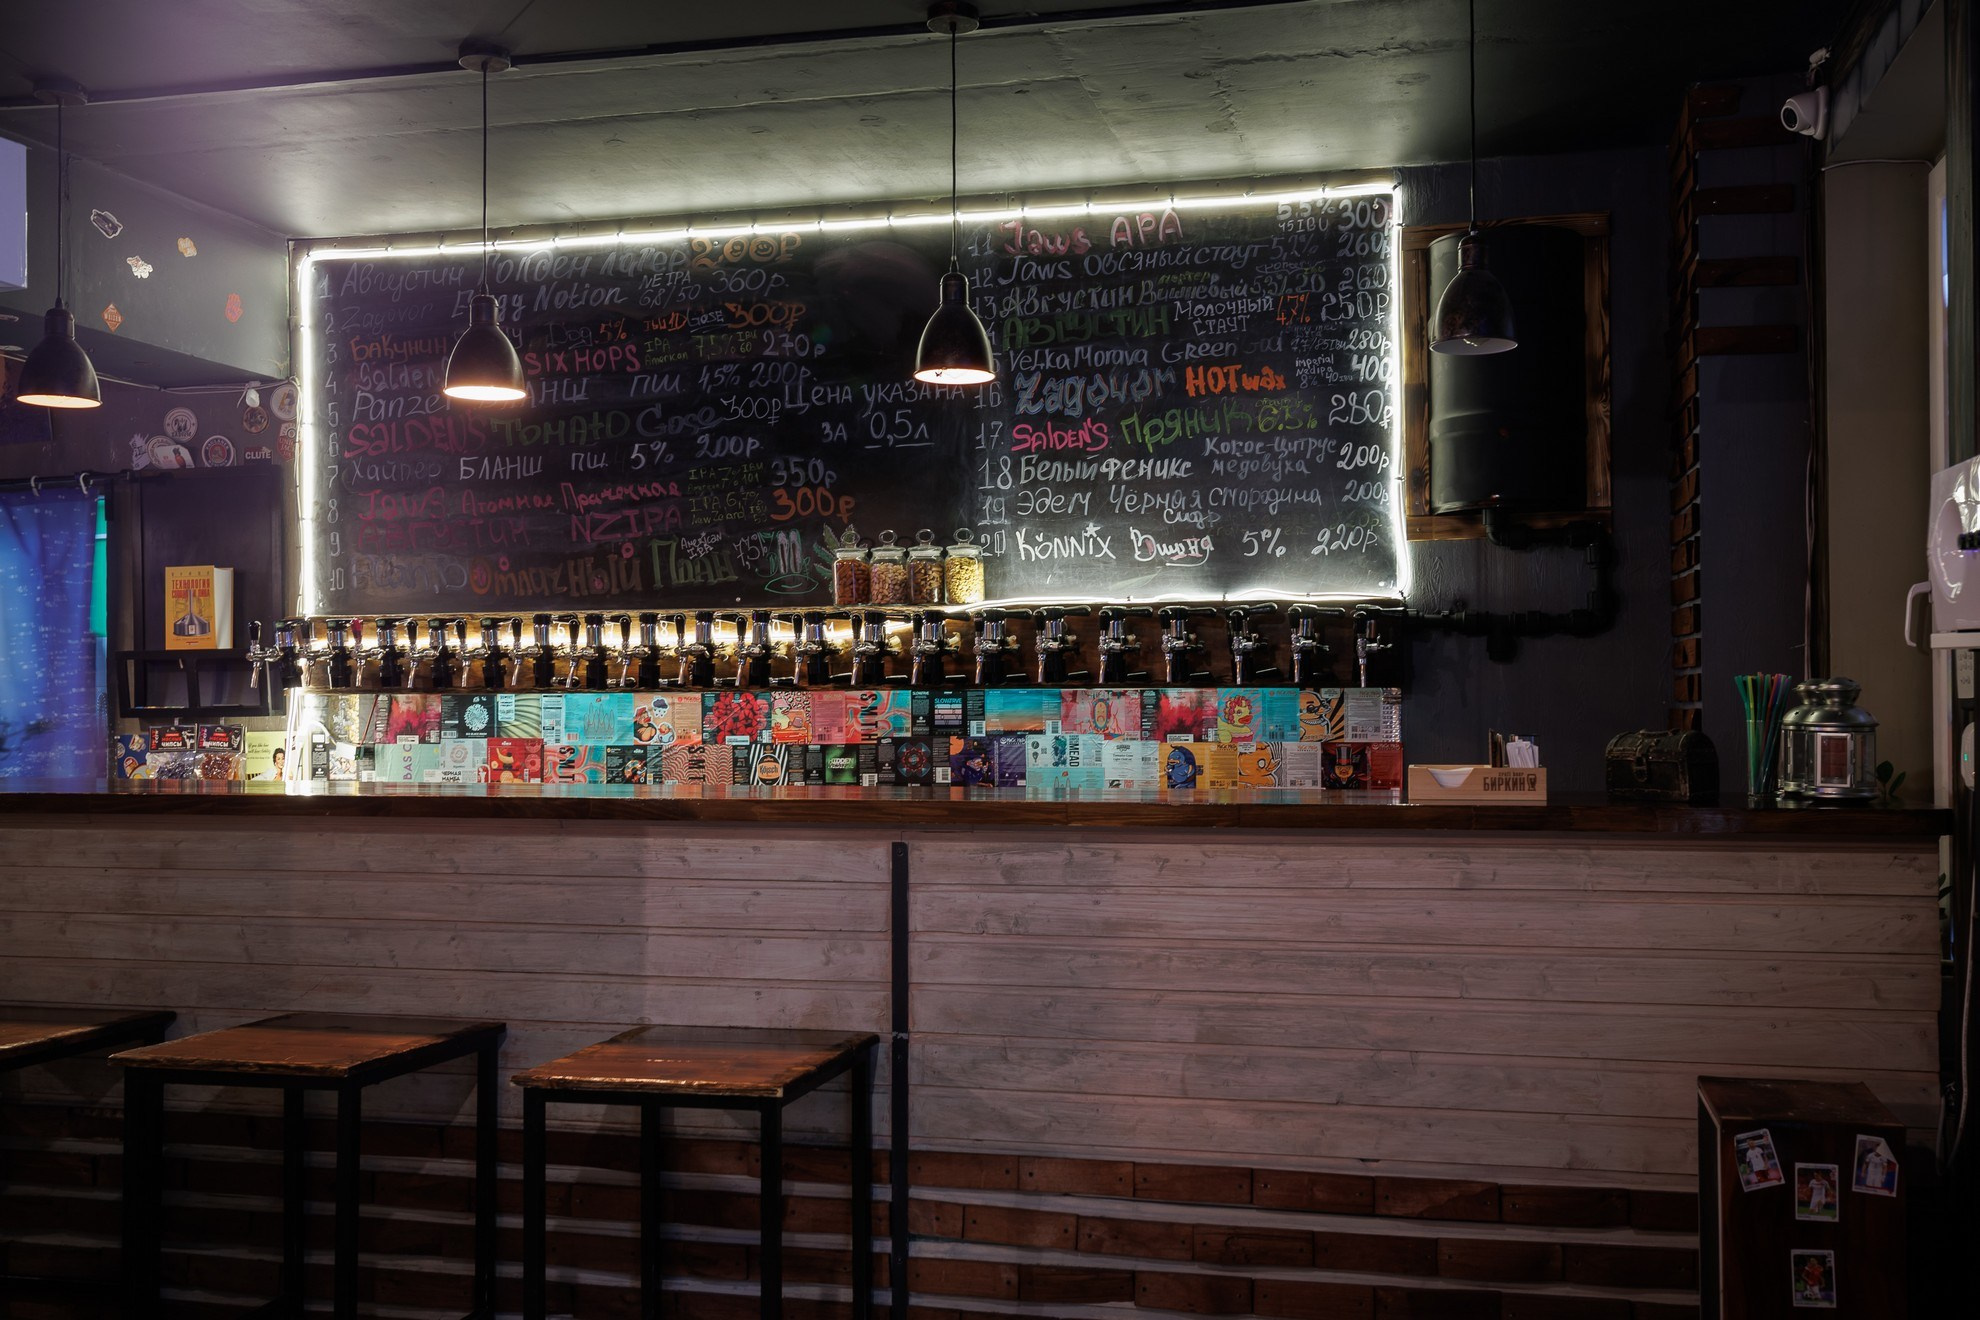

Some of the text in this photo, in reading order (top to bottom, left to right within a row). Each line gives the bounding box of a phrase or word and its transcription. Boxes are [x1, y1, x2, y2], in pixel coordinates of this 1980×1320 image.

[1000, 219, 1092, 256] Jaws
[1110, 208, 1184, 249] APA
[320, 274, 332, 299] 1
[341, 262, 464, 303] Августин
[997, 255, 1074, 287] Jaws
[452, 290, 527, 322] Fgy
[533, 281, 628, 313] Notion
[1172, 296, 1275, 322] Молочный
[574, 343, 642, 374] HOPS
[351, 455, 442, 487] Хайпер
[459, 455, 544, 481] БЛАНШ
[629, 440, 675, 471] 5%
[1018, 452, 1096, 484] Белый
[1015, 487, 1093, 516] Эдем
[1483, 776, 1526, 792] БИРКИН
